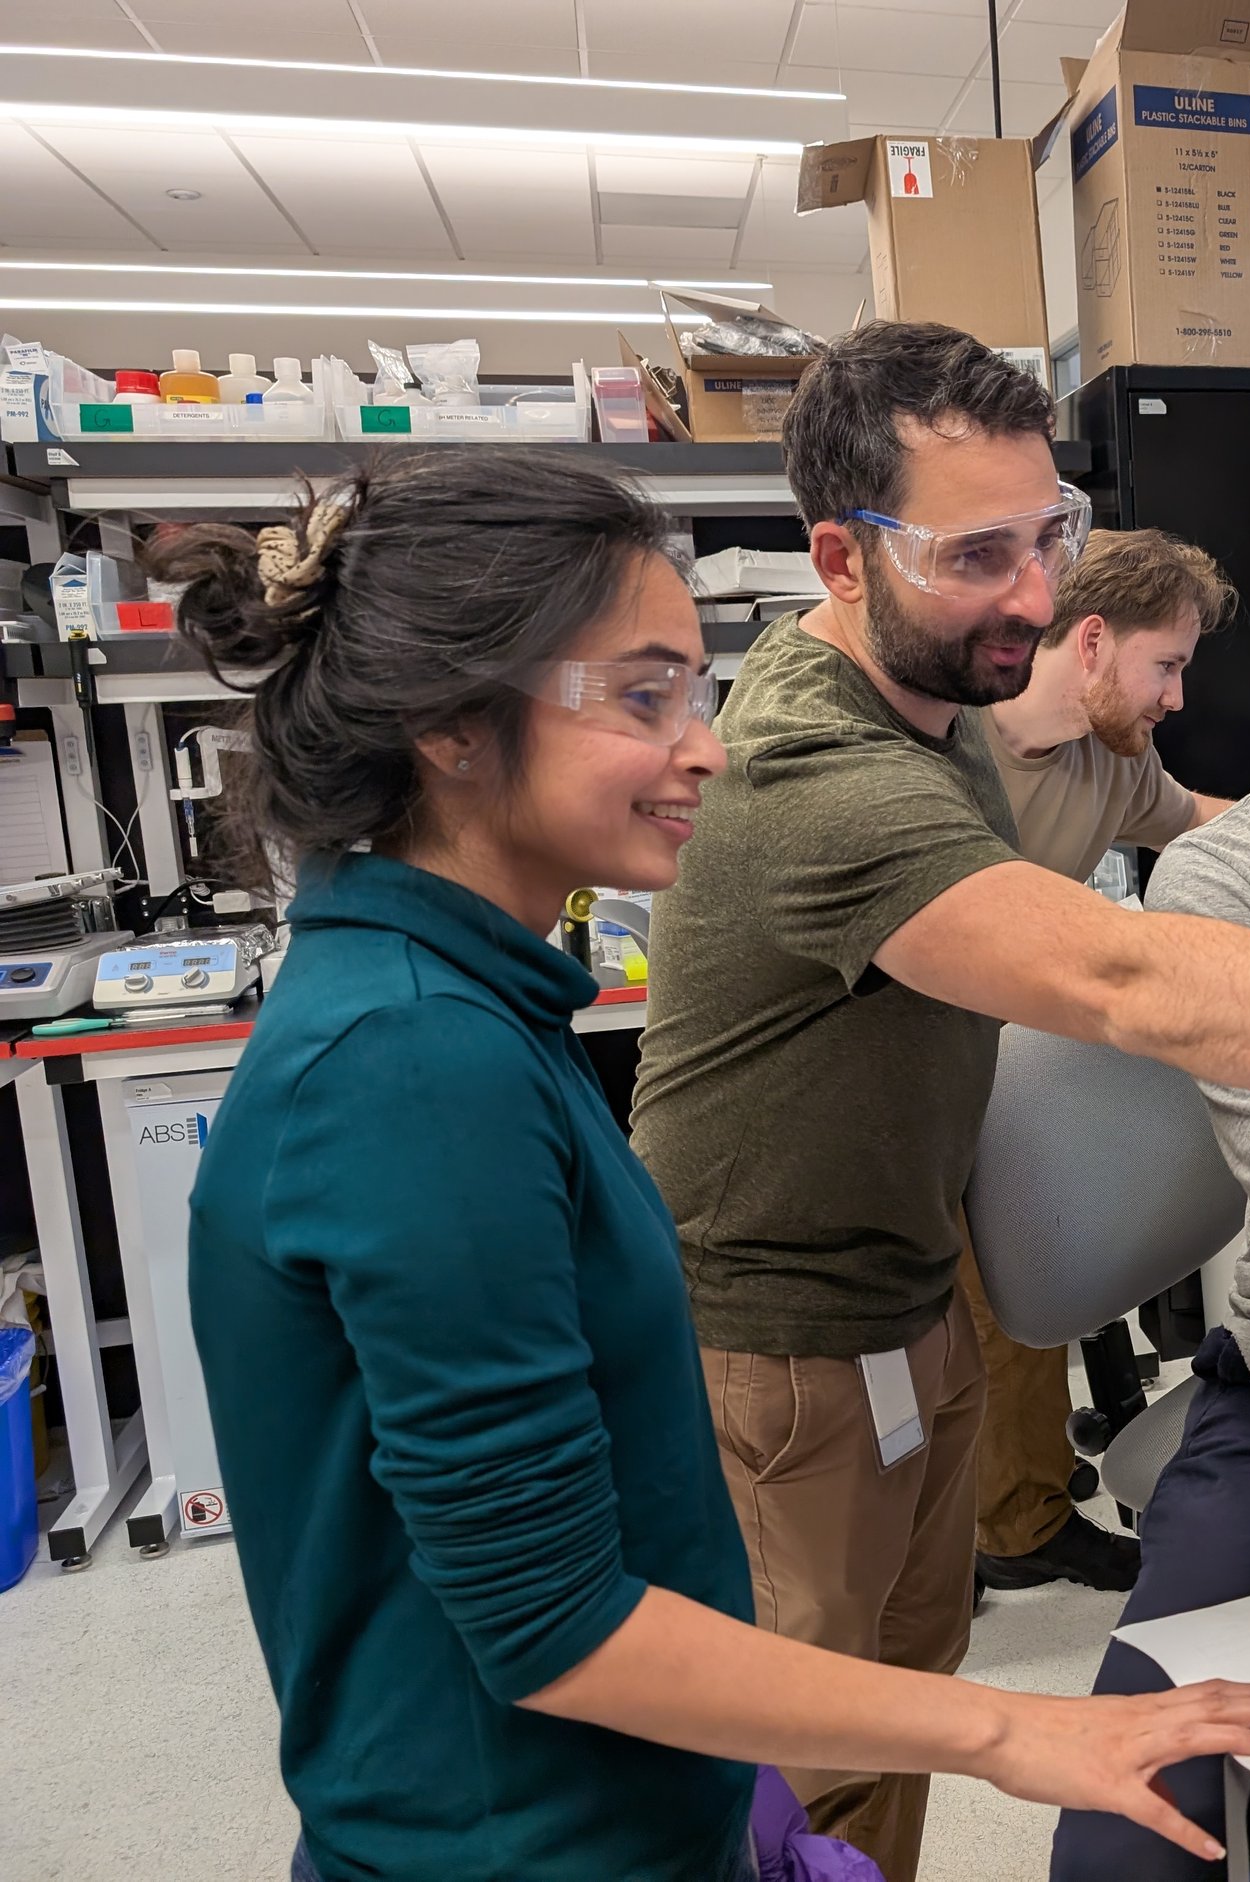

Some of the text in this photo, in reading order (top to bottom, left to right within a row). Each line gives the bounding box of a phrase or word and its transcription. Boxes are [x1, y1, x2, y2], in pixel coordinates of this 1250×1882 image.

[1174, 95, 1215, 112] ULINE
[1141, 110, 1247, 128] PLASTIC STACKABLE BINS
[890, 145, 926, 157] FRAGILE
[1178, 162, 1216, 173] 12/CARTON
[1217, 190, 1236, 198] BLACK
[1218, 217, 1237, 225] CLEAR
[1218, 231, 1238, 239] GREEN
[1219, 244, 1231, 252] RED
[1220, 271, 1243, 279] YELLOW
[714, 381, 743, 390] ULINE
[6, 410, 29, 418] PM-992
[172, 412, 210, 420] DETERGENTS
[138, 608, 157, 627] L
[139, 1122, 186, 1145] ABS
